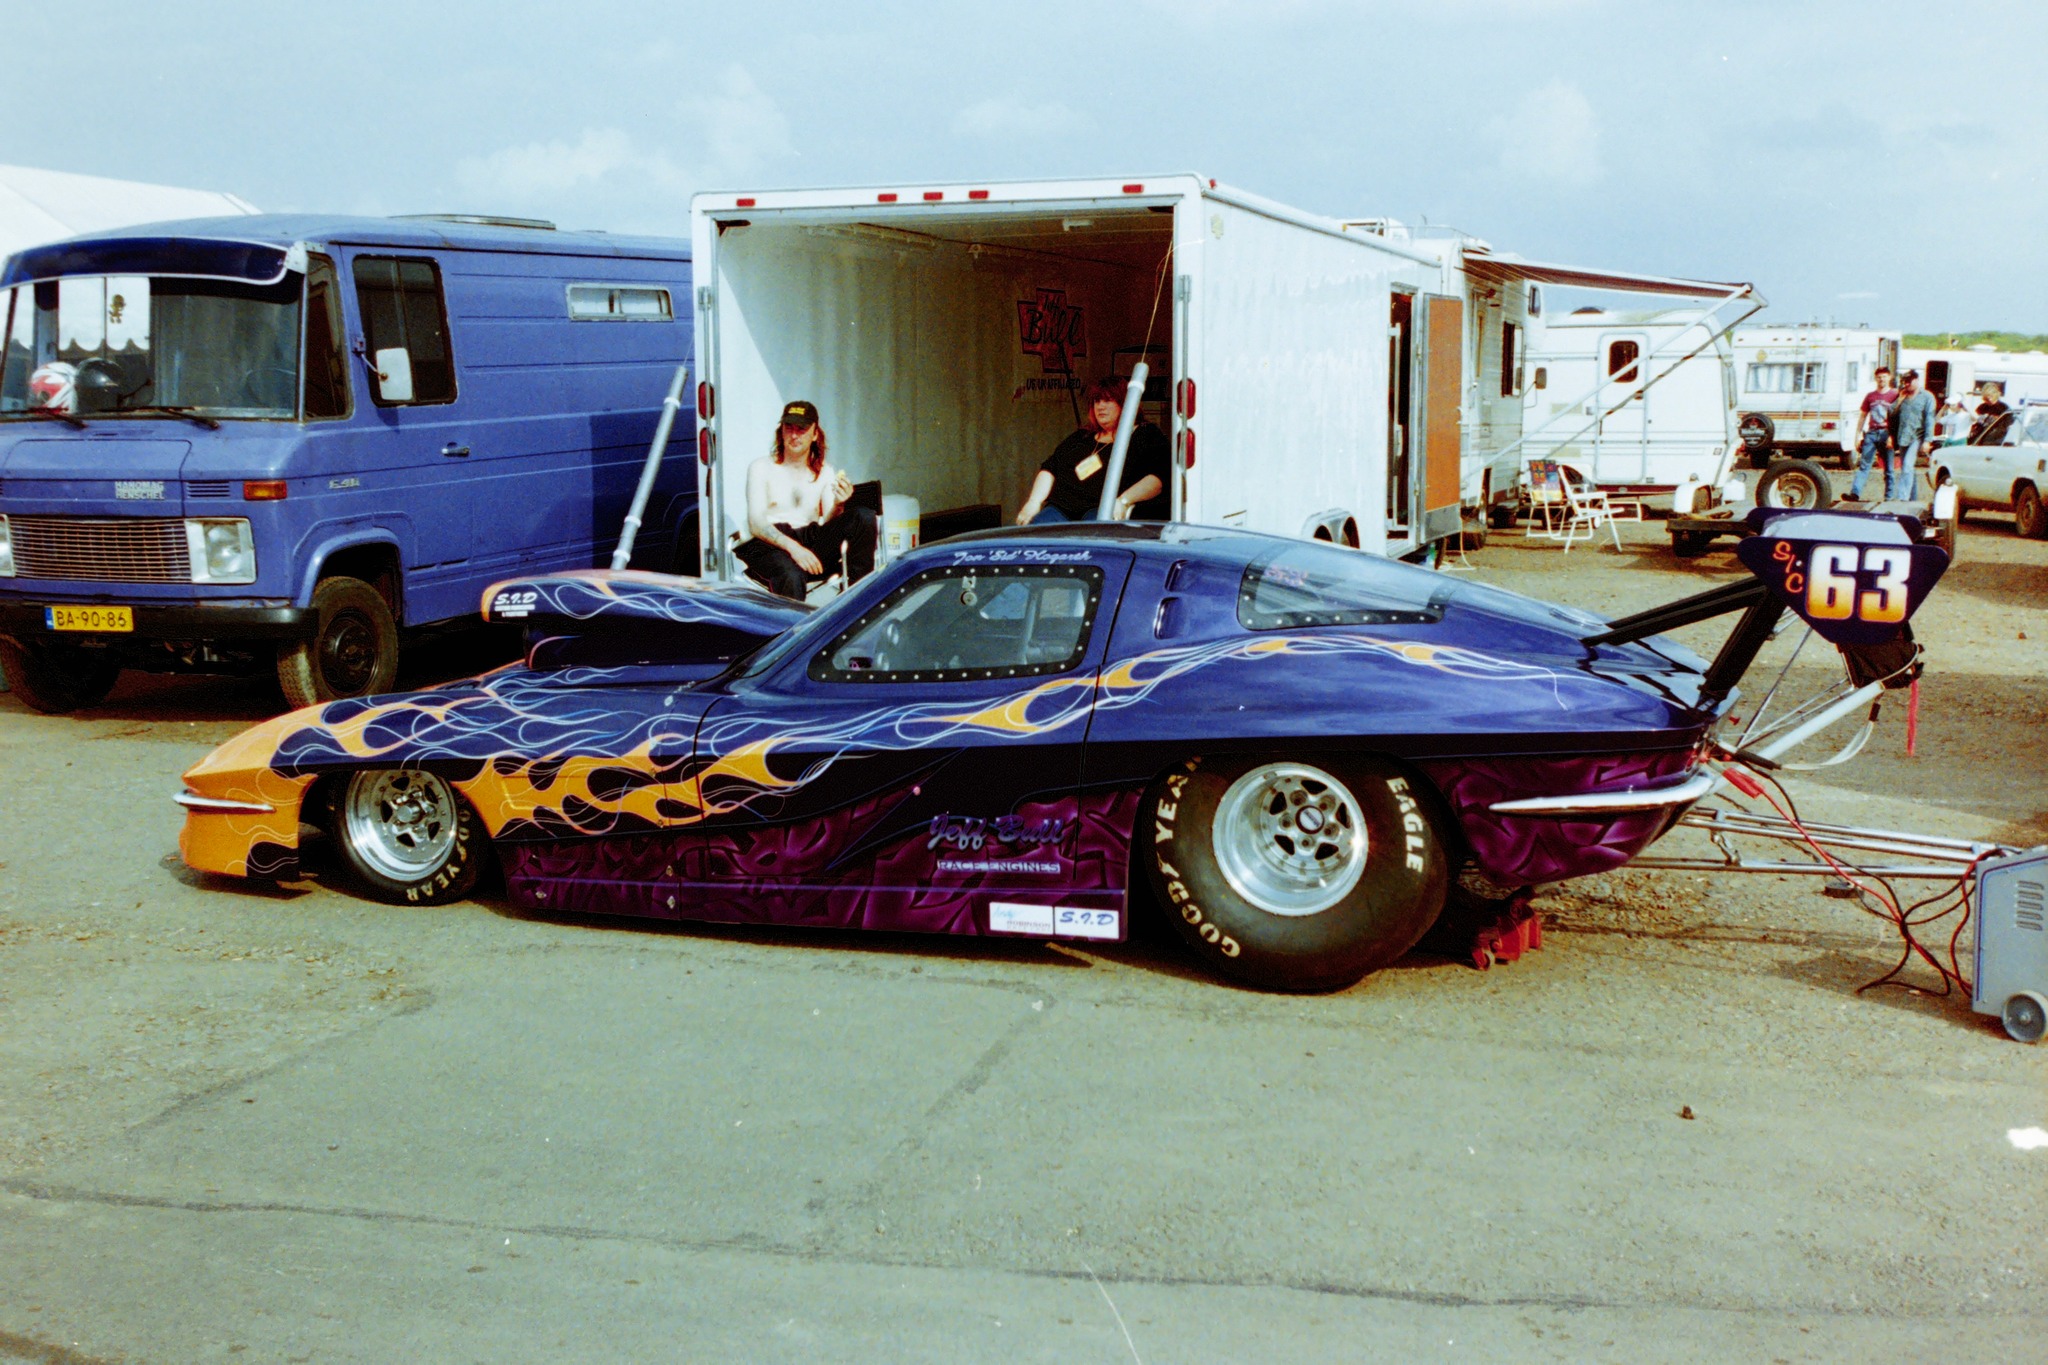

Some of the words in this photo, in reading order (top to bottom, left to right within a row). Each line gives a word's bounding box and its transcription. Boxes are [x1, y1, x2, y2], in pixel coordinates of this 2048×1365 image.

[1806, 543, 1911, 623] 63
[56, 611, 127, 628] BA-90-86
[927, 813, 988, 851] Jeff
[995, 814, 1064, 844] Bull
[1386, 777, 1423, 873] EAGLE
[938, 860, 983, 872] RACE
[988, 862, 1060, 873] ENGINES
